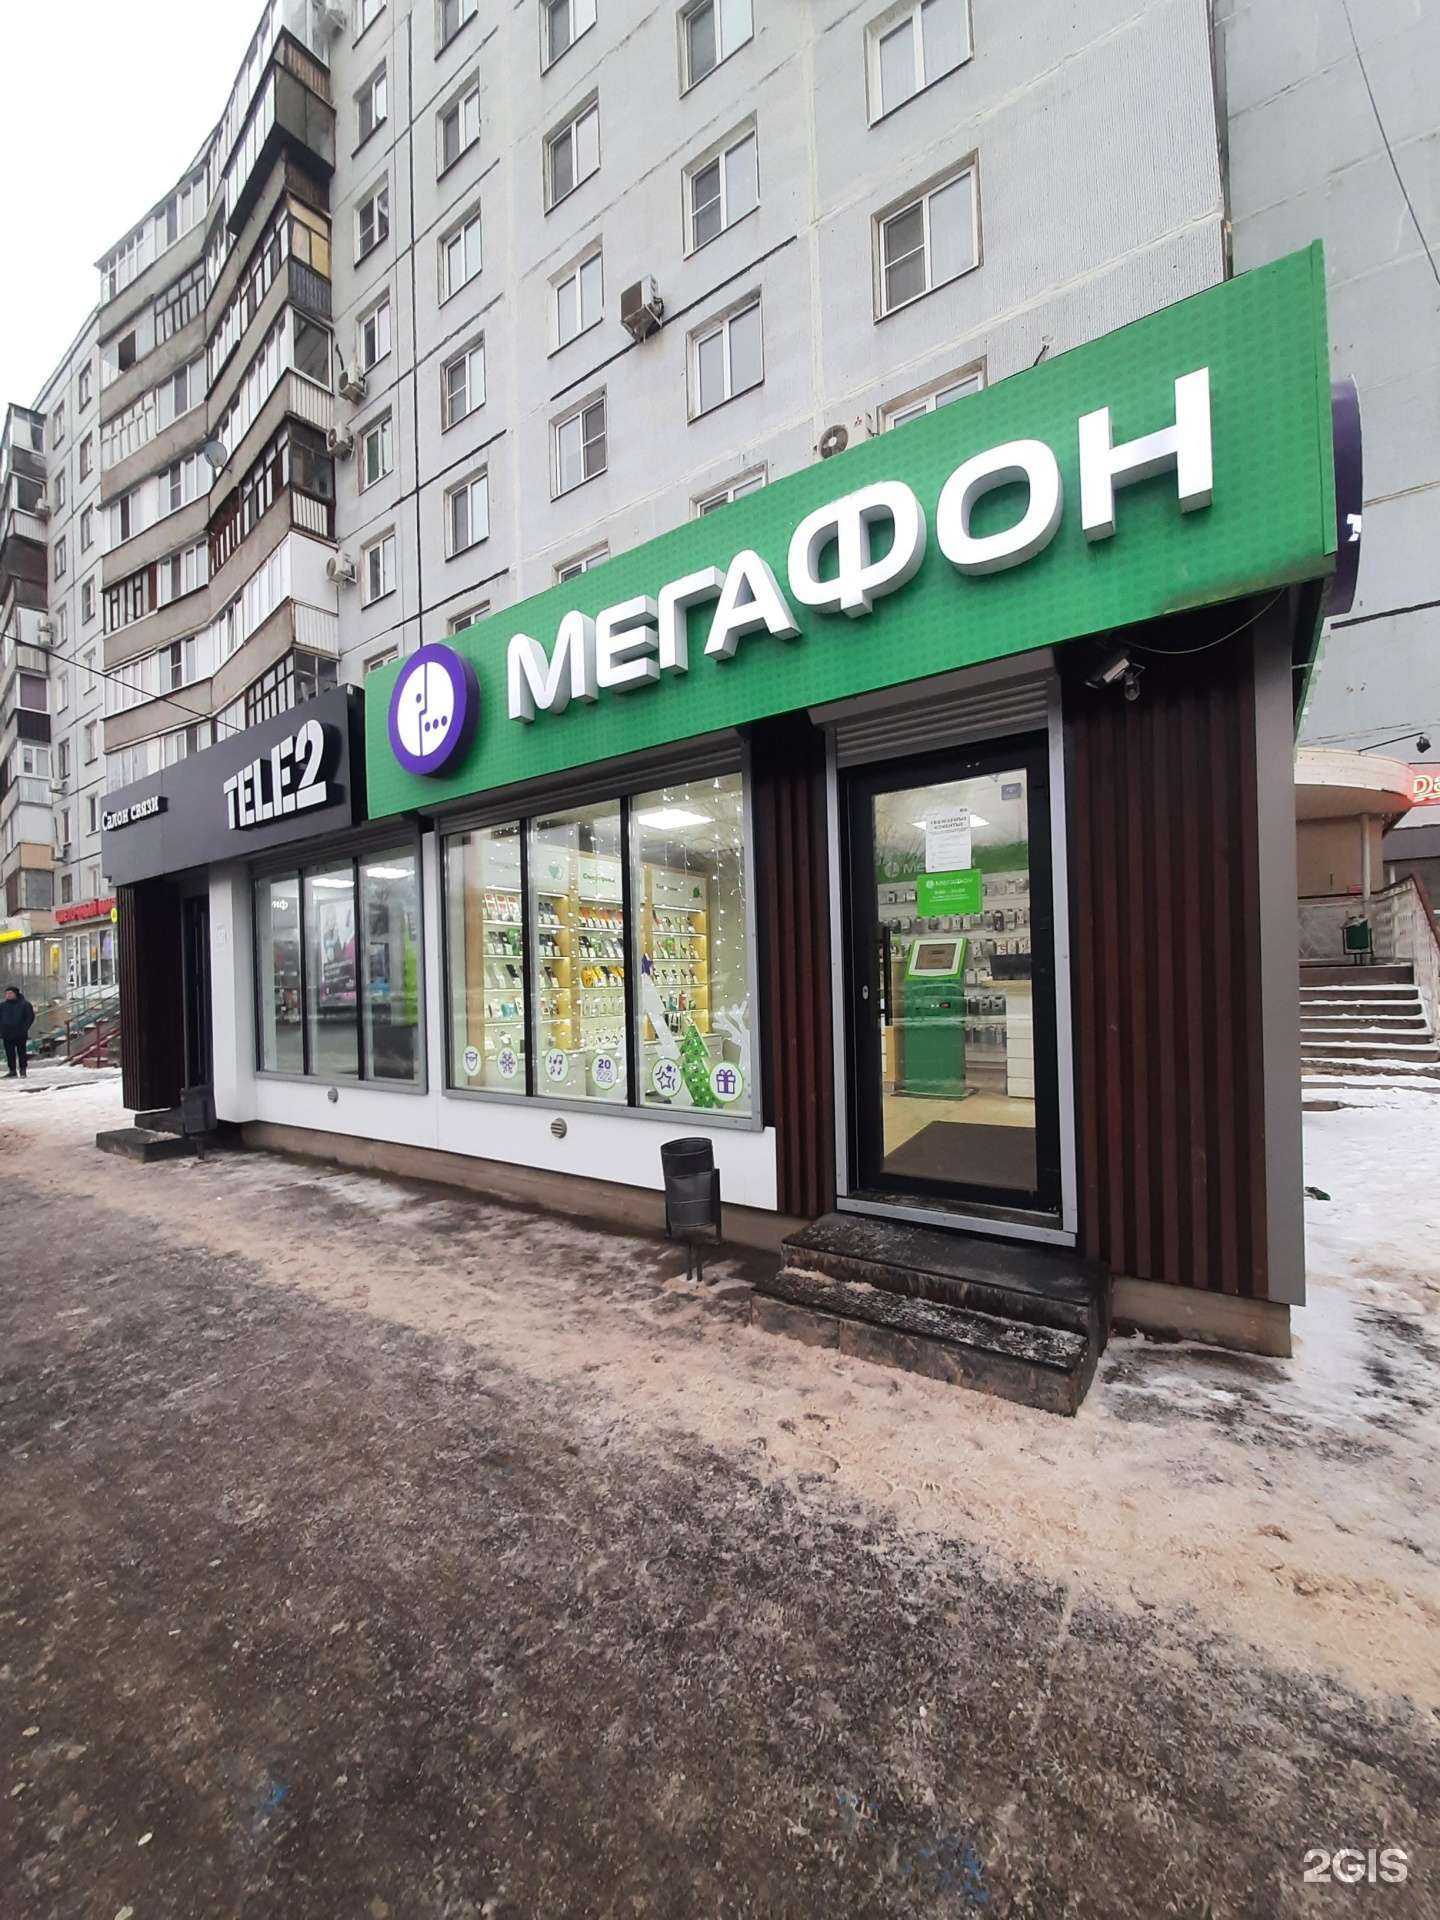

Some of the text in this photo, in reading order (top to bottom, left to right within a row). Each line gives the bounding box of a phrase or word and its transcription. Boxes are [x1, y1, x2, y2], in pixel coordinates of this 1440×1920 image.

[507, 366, 1213, 724] МЕГАФОН
[223, 719, 328, 830] TELE2
[102, 796, 159, 831] Салон связи
[598, 1059, 611, 1070] 20
